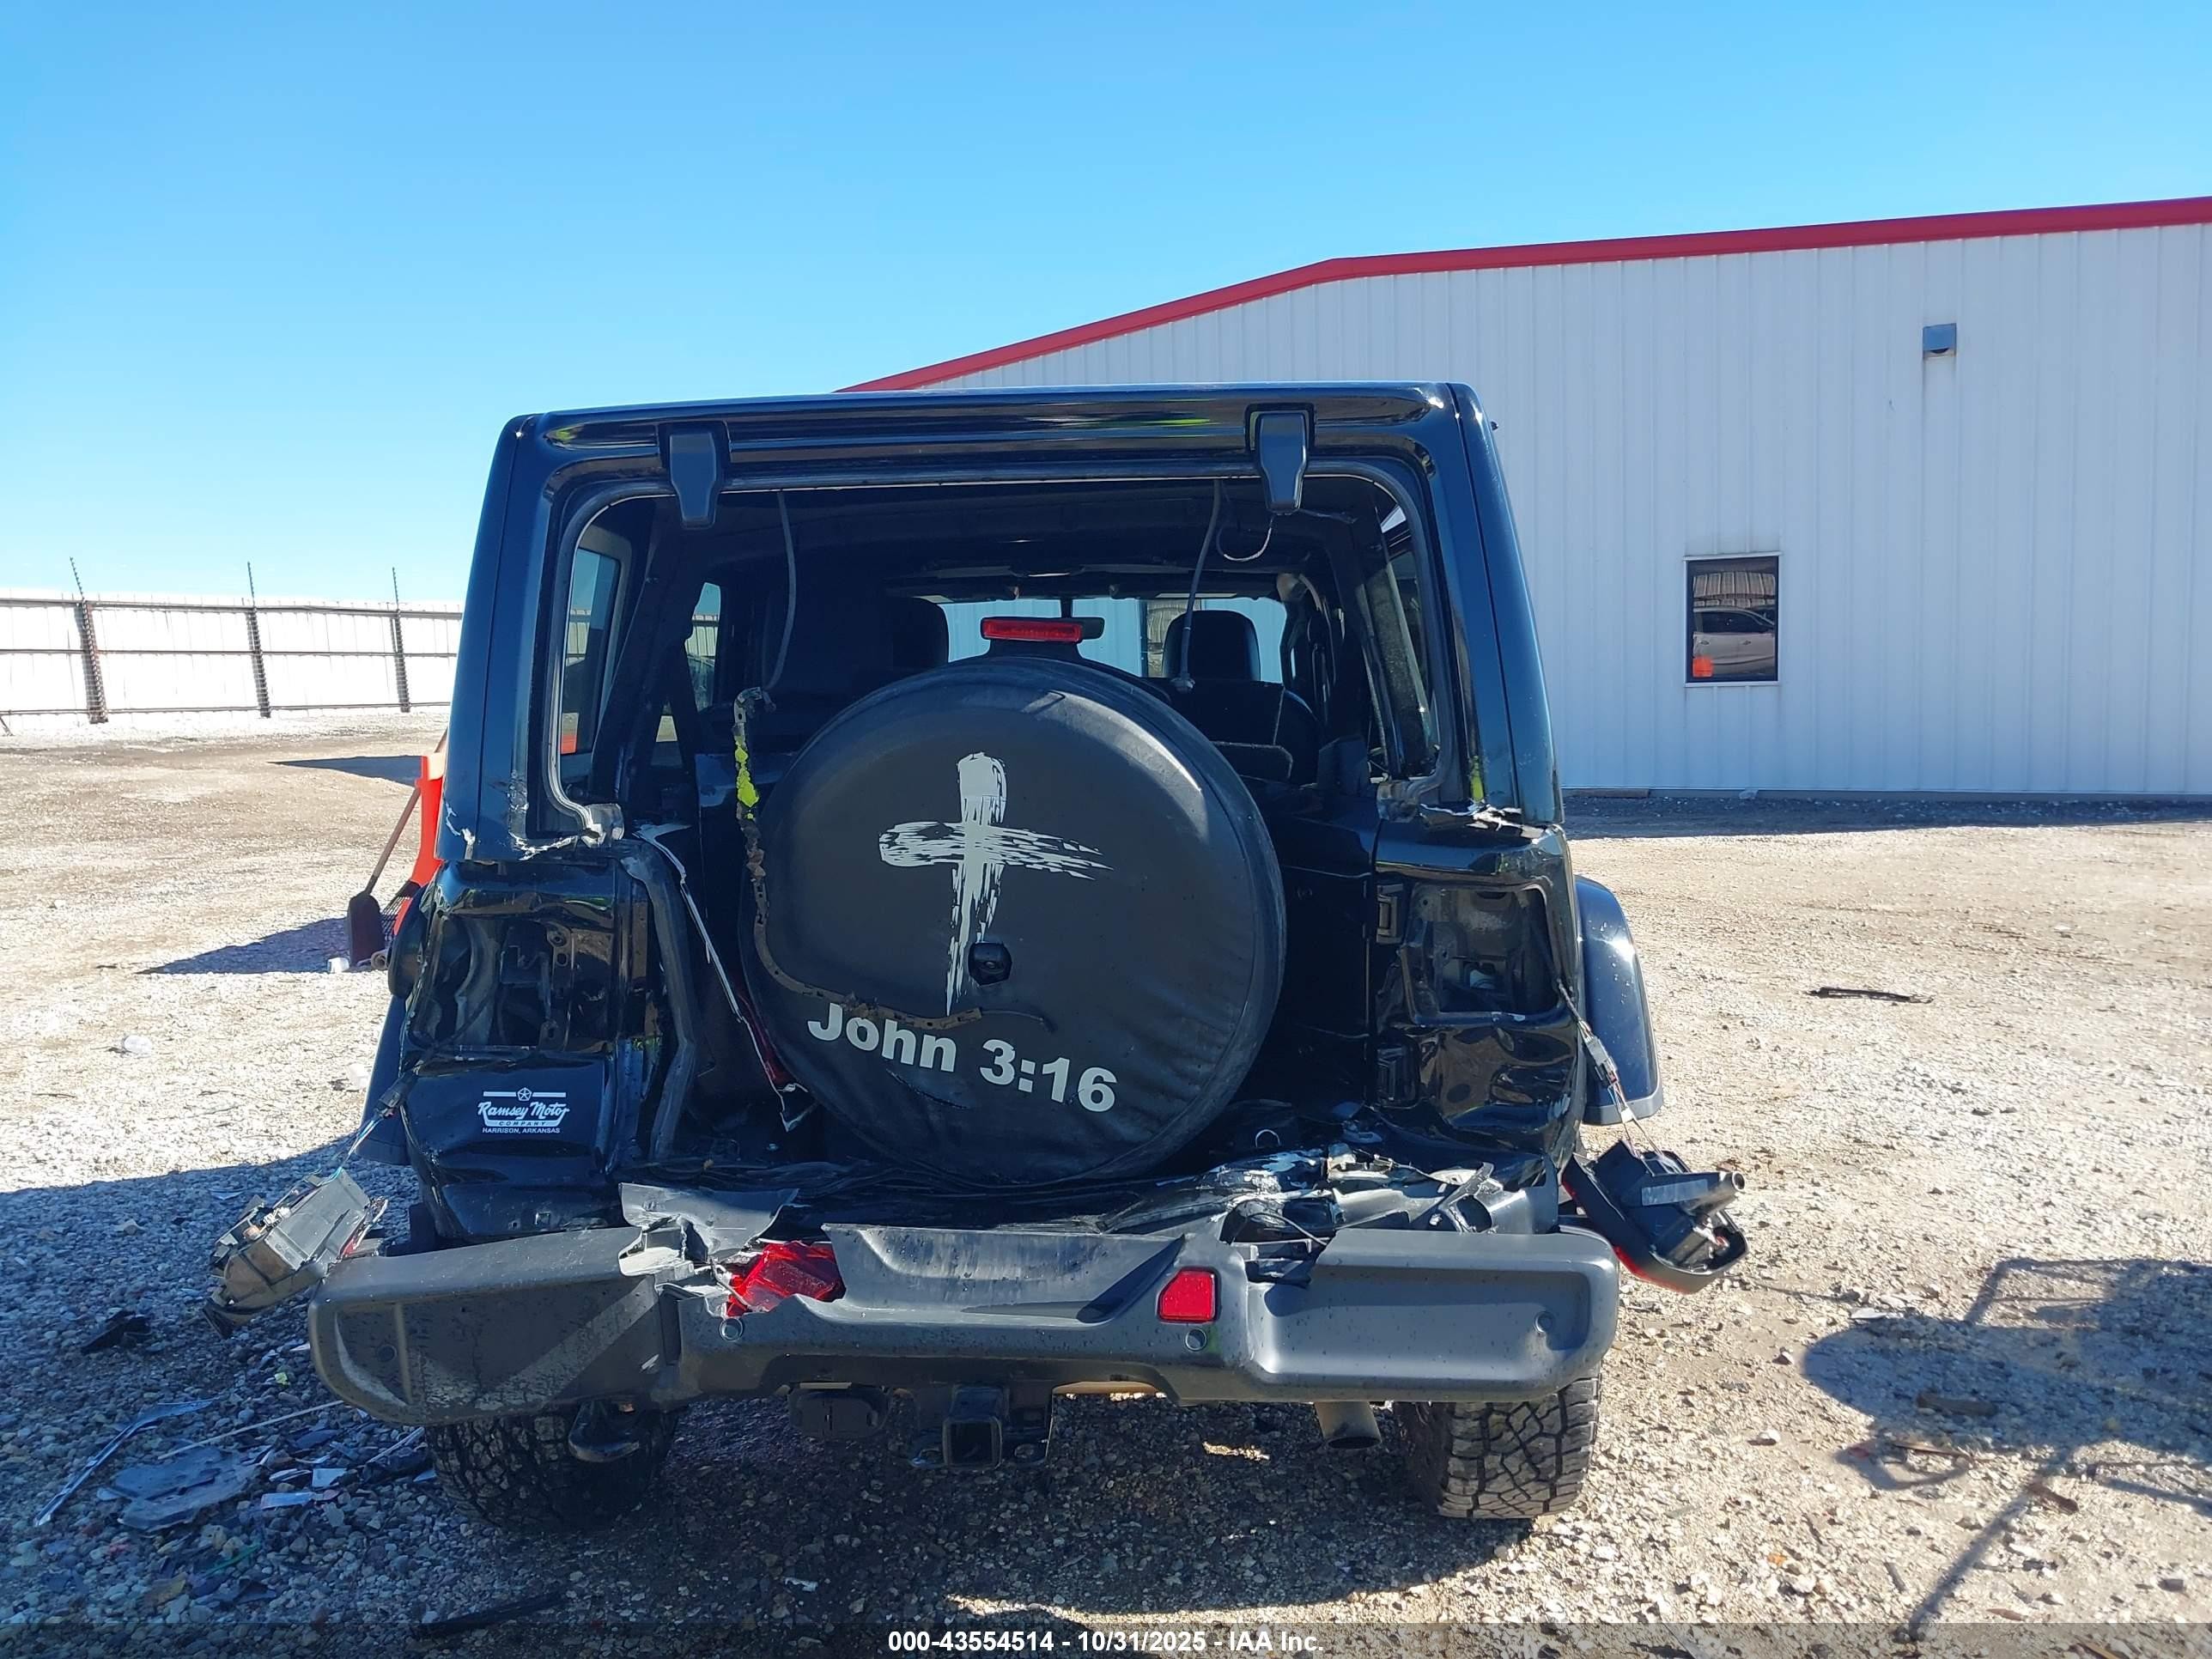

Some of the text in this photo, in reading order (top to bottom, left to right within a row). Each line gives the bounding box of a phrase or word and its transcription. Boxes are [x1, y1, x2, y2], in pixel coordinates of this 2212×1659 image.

[807, 1003, 1117, 1112] John 3:16
[477, 1102, 570, 1120] Ramsey Motor
